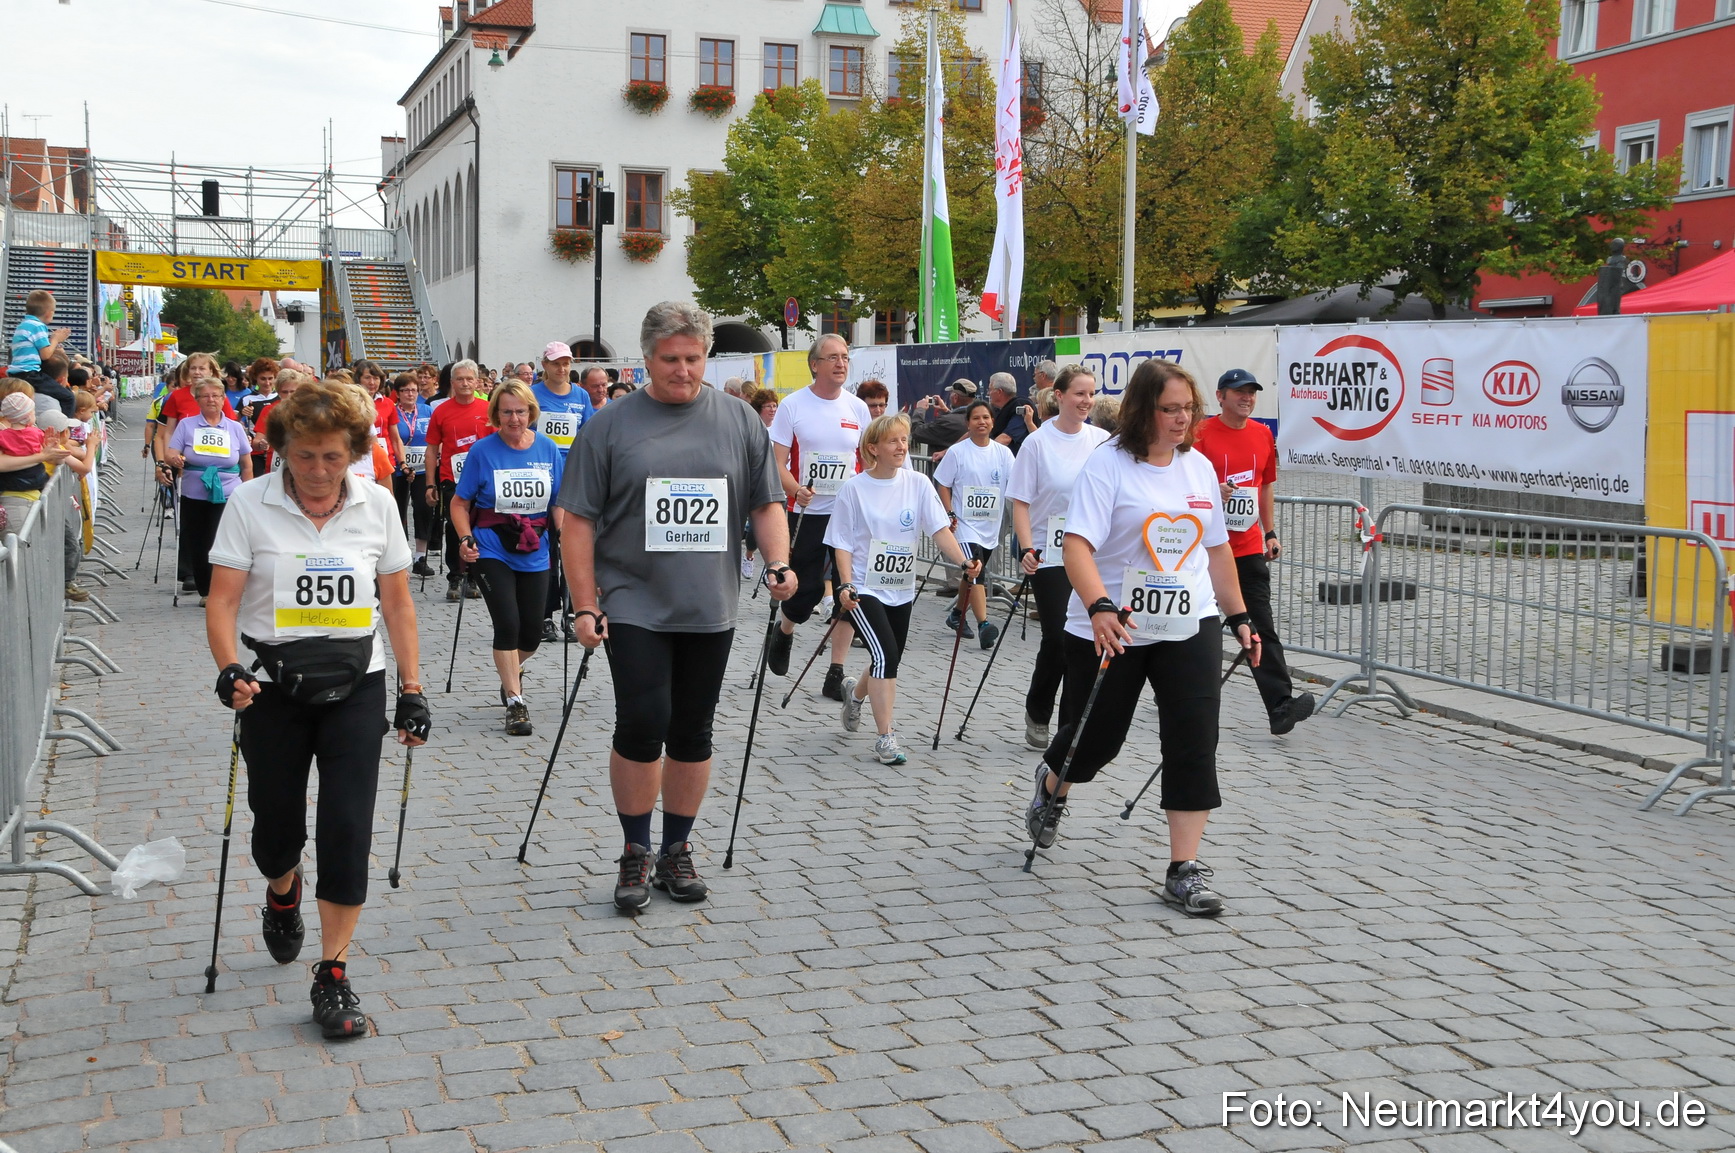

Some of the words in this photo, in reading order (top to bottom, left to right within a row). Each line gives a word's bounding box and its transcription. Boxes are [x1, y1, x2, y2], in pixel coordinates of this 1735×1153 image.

[172, 261, 249, 281] START
[1289, 361, 1378, 386] GERHART
[1379, 367, 1388, 381] &
[1492, 372, 1531, 396] KIA
[1290, 387, 1328, 400] Autohaus
[1327, 387, 1389, 412] JÄNIG
[1567, 389, 1619, 401] NISSAN
[1412, 412, 1463, 426] SEAT
[1472, 413, 1491, 428] KIA
[1494, 414, 1548, 431] MOTORS
[545, 421, 570, 435] 865
[201, 434, 224, 447] 858
[405, 453, 426, 464] 807
[809, 462, 847, 480] 8077
[1287, 449, 1327, 466] Neumarkt
[1331, 452, 1384, 472] Sengenthal
[1392, 456, 1409, 473] Tel.
[1409, 459, 1455, 478] 09181/26
[1455, 463, 1480, 480] 80-0
[1488, 469, 1629, 496] www.gerhart-jaenig.de
[502, 480, 545, 498] 8050
[670, 483, 706, 492] BOCK
[511, 501, 536, 510] Margit
[967, 495, 996, 509] 8027
[656, 497, 719, 525] 8022
[1225, 517, 1245, 526] Josef
[665, 530, 710, 543] Gerhard
[1157, 525, 1188, 534] Servus
[1159, 536, 1182, 544] Fan's
[1156, 547, 1183, 555] Danke
[874, 553, 914, 574] 8032
[880, 575, 905, 585] Sabine
[1145, 574, 1178, 584] BOCK
[295, 574, 355, 606] 850
[1131, 587, 1191, 616] 8078
[300, 611, 347, 627] Helene
